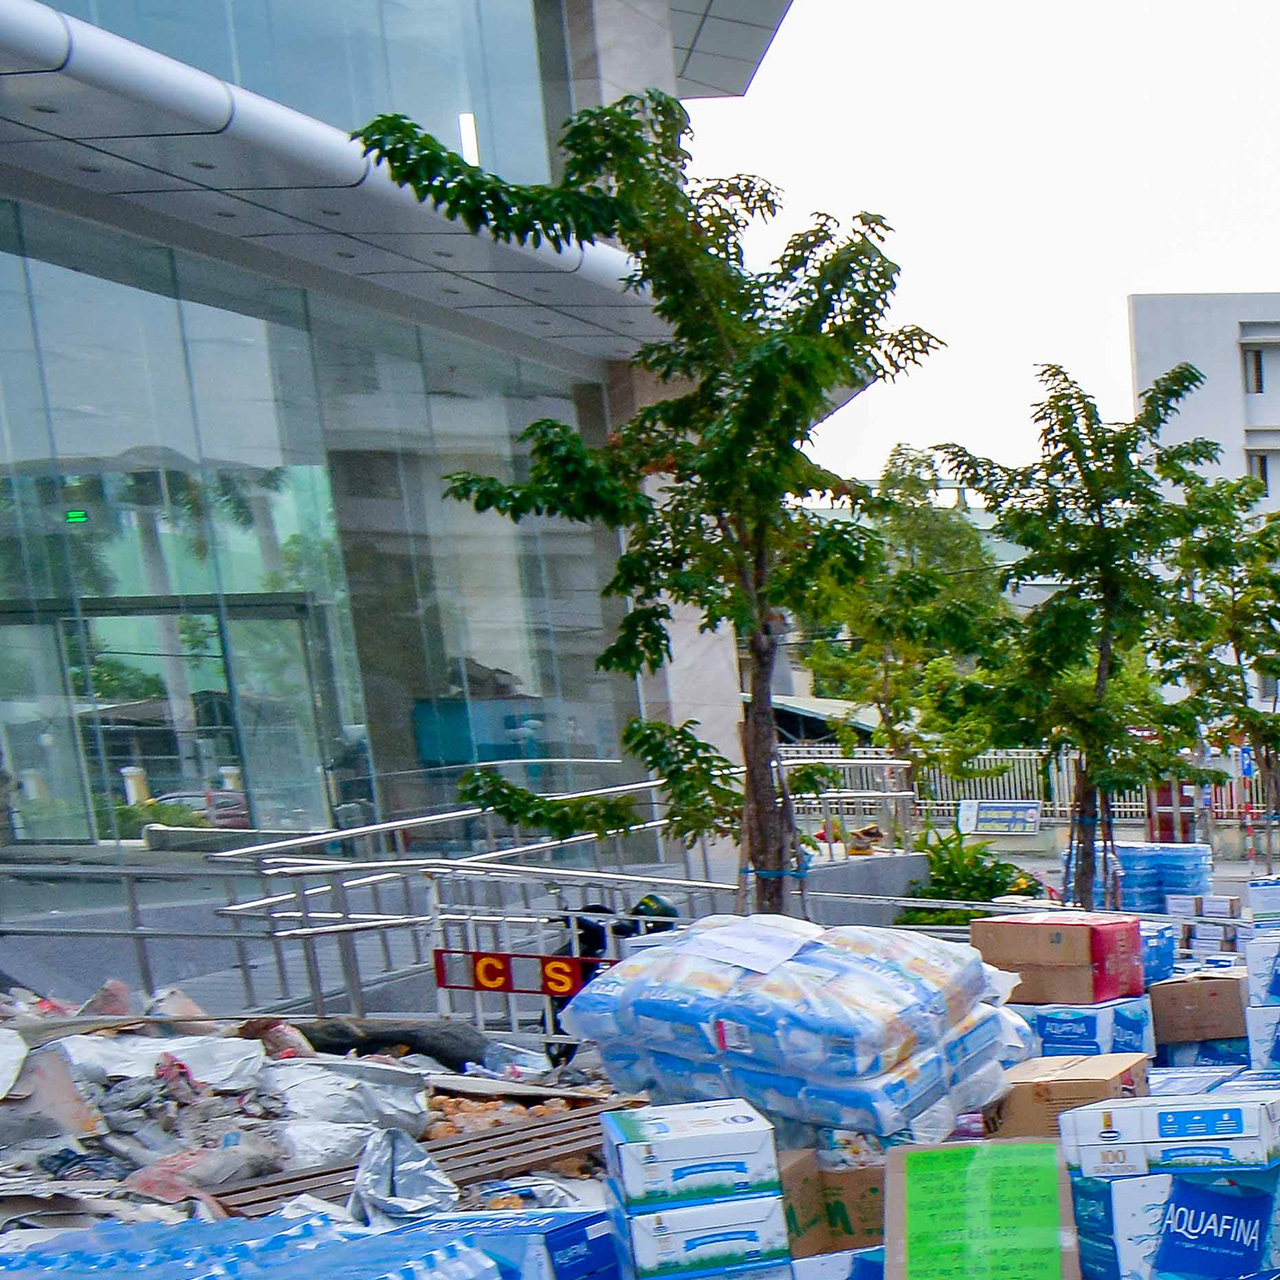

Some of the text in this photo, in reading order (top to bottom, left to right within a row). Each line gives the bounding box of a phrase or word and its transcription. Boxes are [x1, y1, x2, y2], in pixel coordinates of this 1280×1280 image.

[475, 956, 505, 988] C
[543, 960, 575, 992] S
[1160, 1201, 1262, 1252] AQUAFINA
